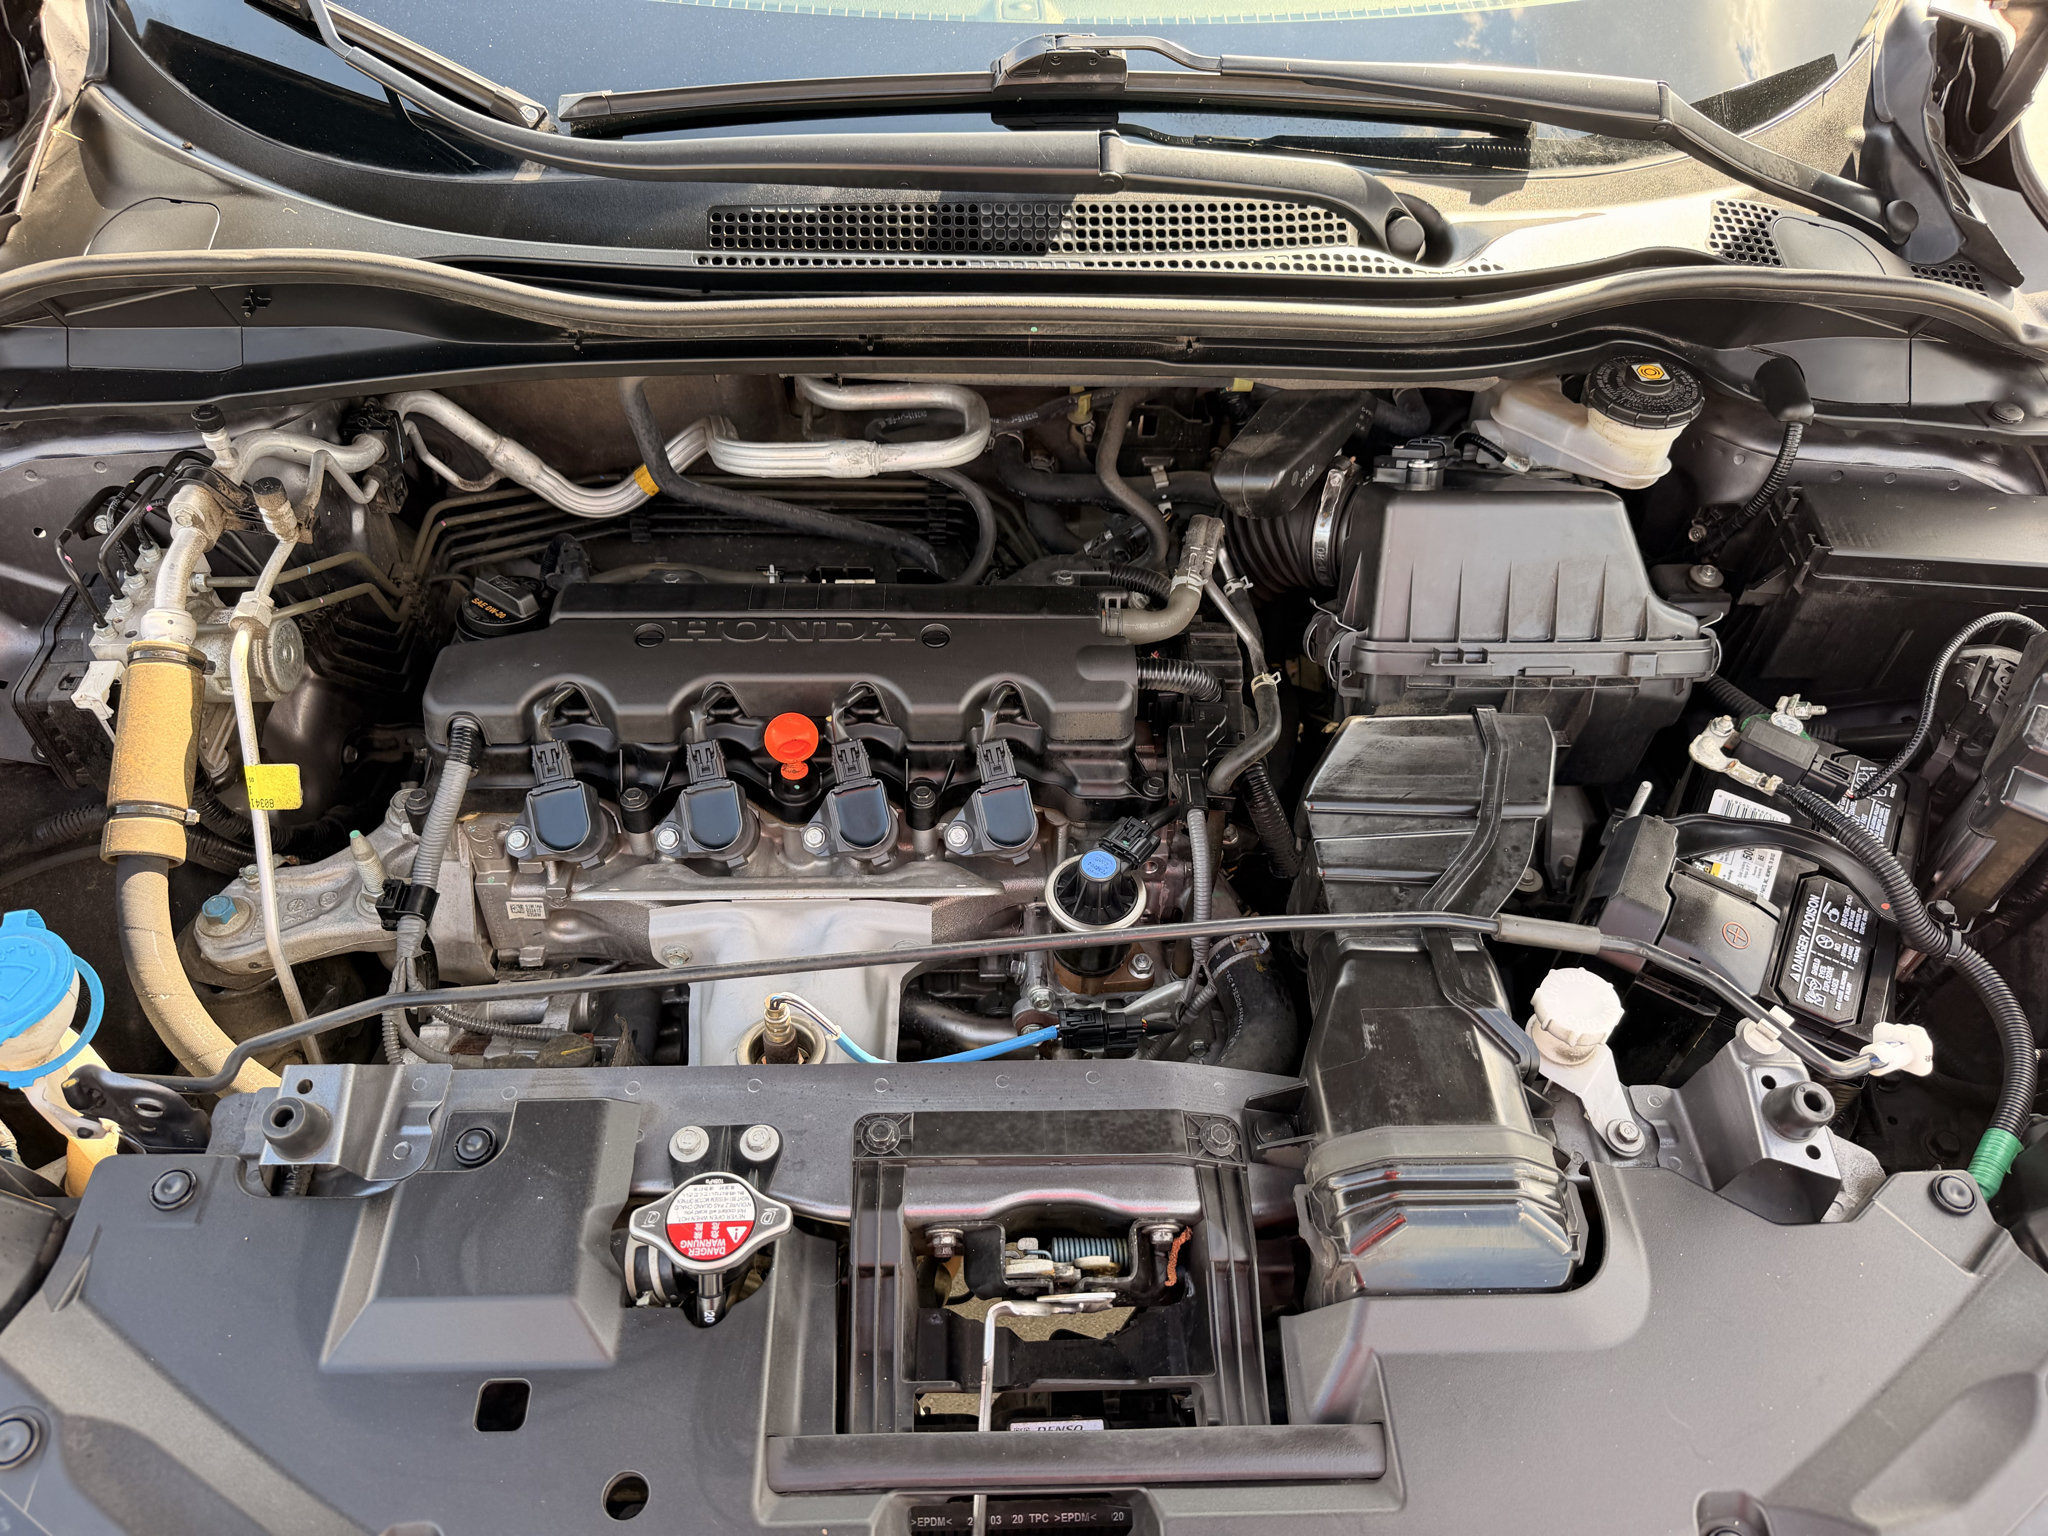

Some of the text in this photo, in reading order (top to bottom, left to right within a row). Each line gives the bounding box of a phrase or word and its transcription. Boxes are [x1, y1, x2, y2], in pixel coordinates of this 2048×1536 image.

[471, 597, 488, 608] SAE
[668, 620, 916, 644] HONDA
[251, 798, 275, 808] 80341
[1792, 935, 1809, 972] DANGER
[1803, 894, 1820, 928] POISON
[680, 1238, 726, 1248] WARNUNG
[688, 1246, 725, 1256] DANGER
[911, 1516, 952, 1527] >EPDM<
[990, 1515, 1002, 1525] 03
[1012, 1514, 1023, 1524] 20
[1029, 1513, 1049, 1523] TPC
[1054, 1512, 1096, 1522] >EPDM<
